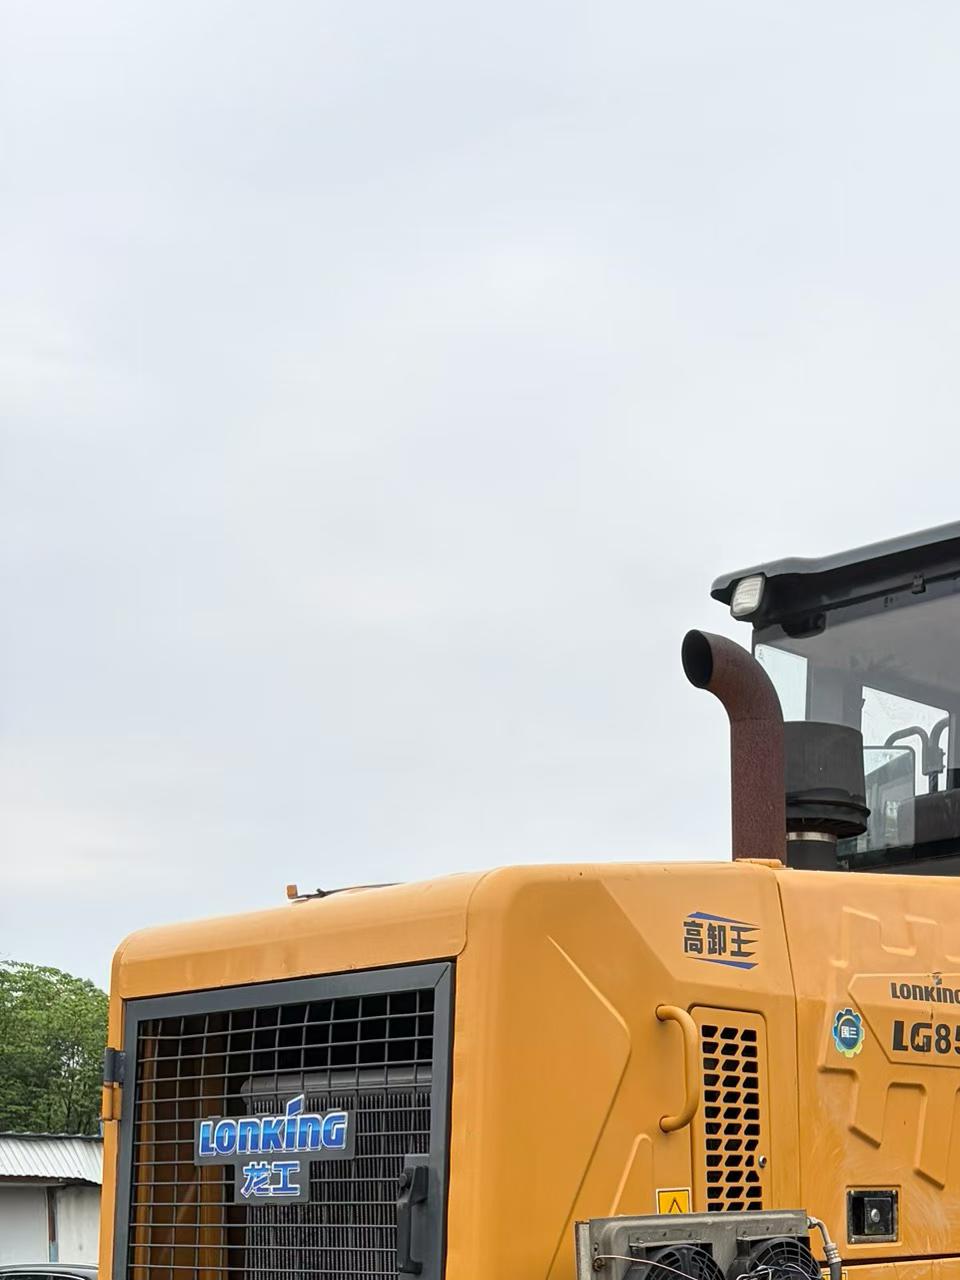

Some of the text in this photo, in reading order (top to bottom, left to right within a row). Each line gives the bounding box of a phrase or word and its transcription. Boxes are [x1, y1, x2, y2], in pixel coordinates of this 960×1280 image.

[683, 920, 760, 957] 高卸王
[241, 1161, 300, 1198] 龙工
